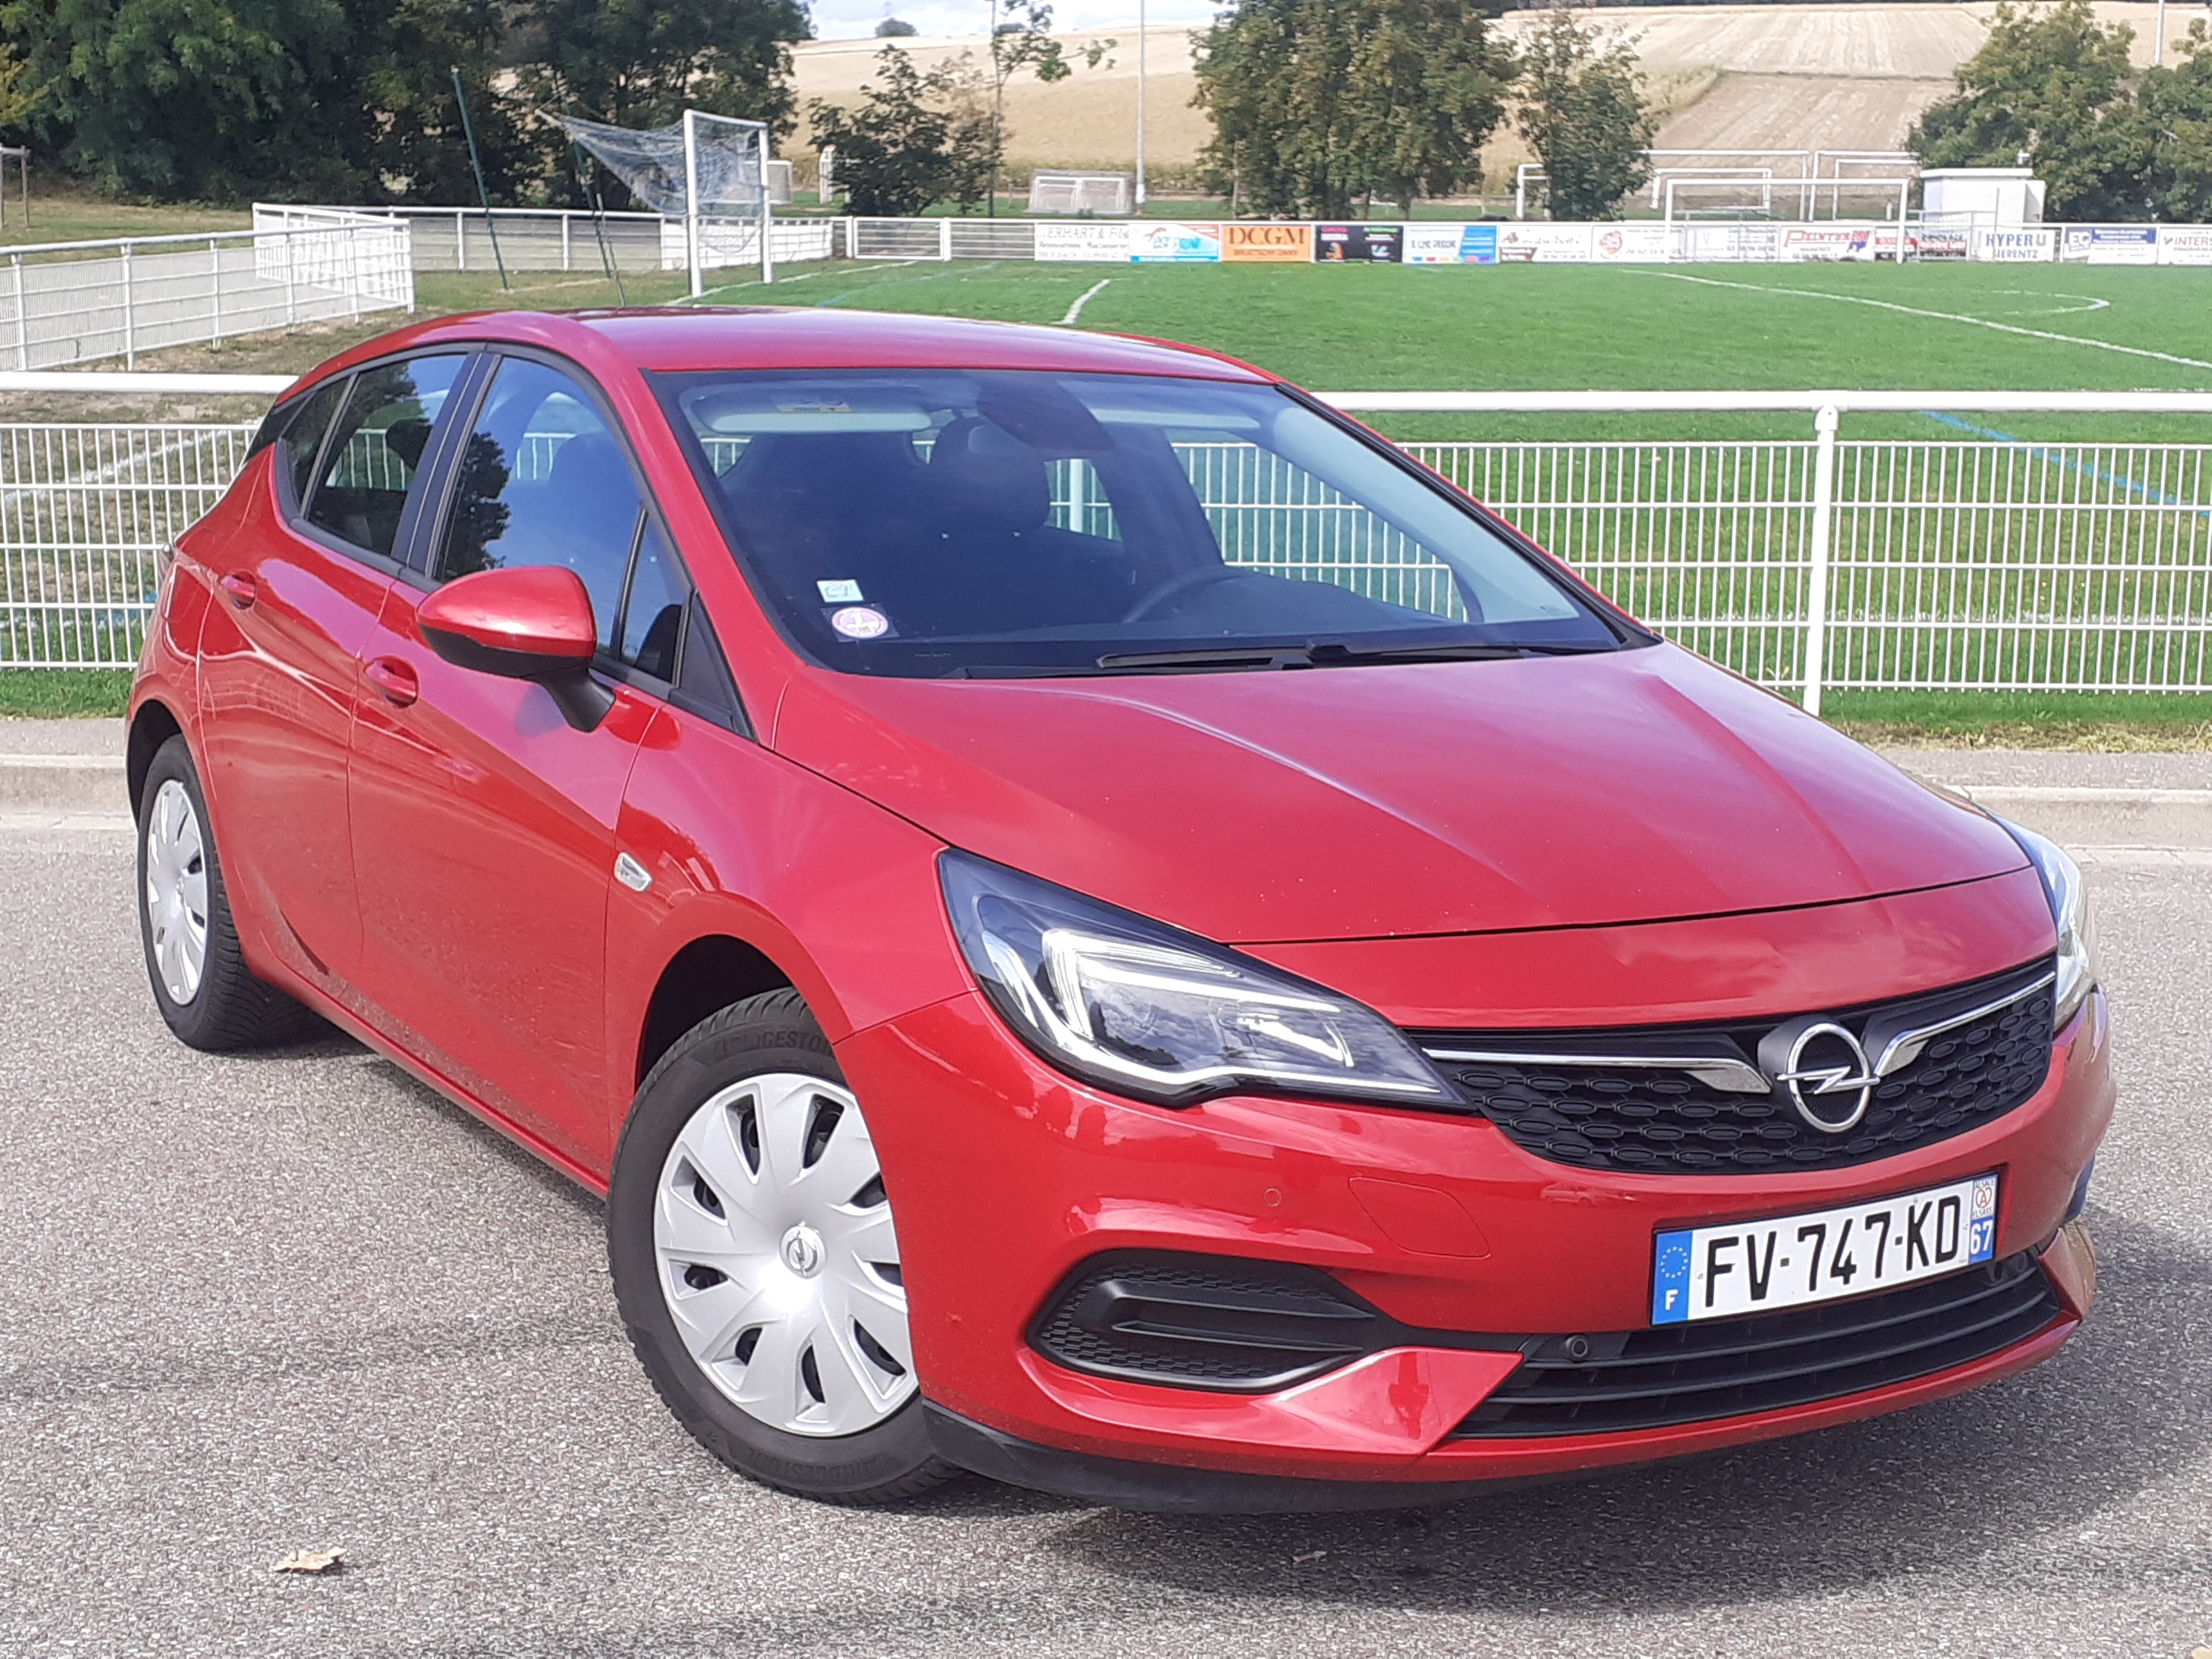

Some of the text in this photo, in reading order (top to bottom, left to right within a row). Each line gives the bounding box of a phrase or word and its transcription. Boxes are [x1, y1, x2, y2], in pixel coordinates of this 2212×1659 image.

[1048, 227, 1095, 238] ERHART
[1229, 227, 1304, 244] DCGM
[1985, 233, 2046, 246] HYPER U
[1970, 1221, 1994, 1255] 67
[1705, 1195, 1961, 1308] FV-747-KD
[1665, 1289, 1678, 1311] F
